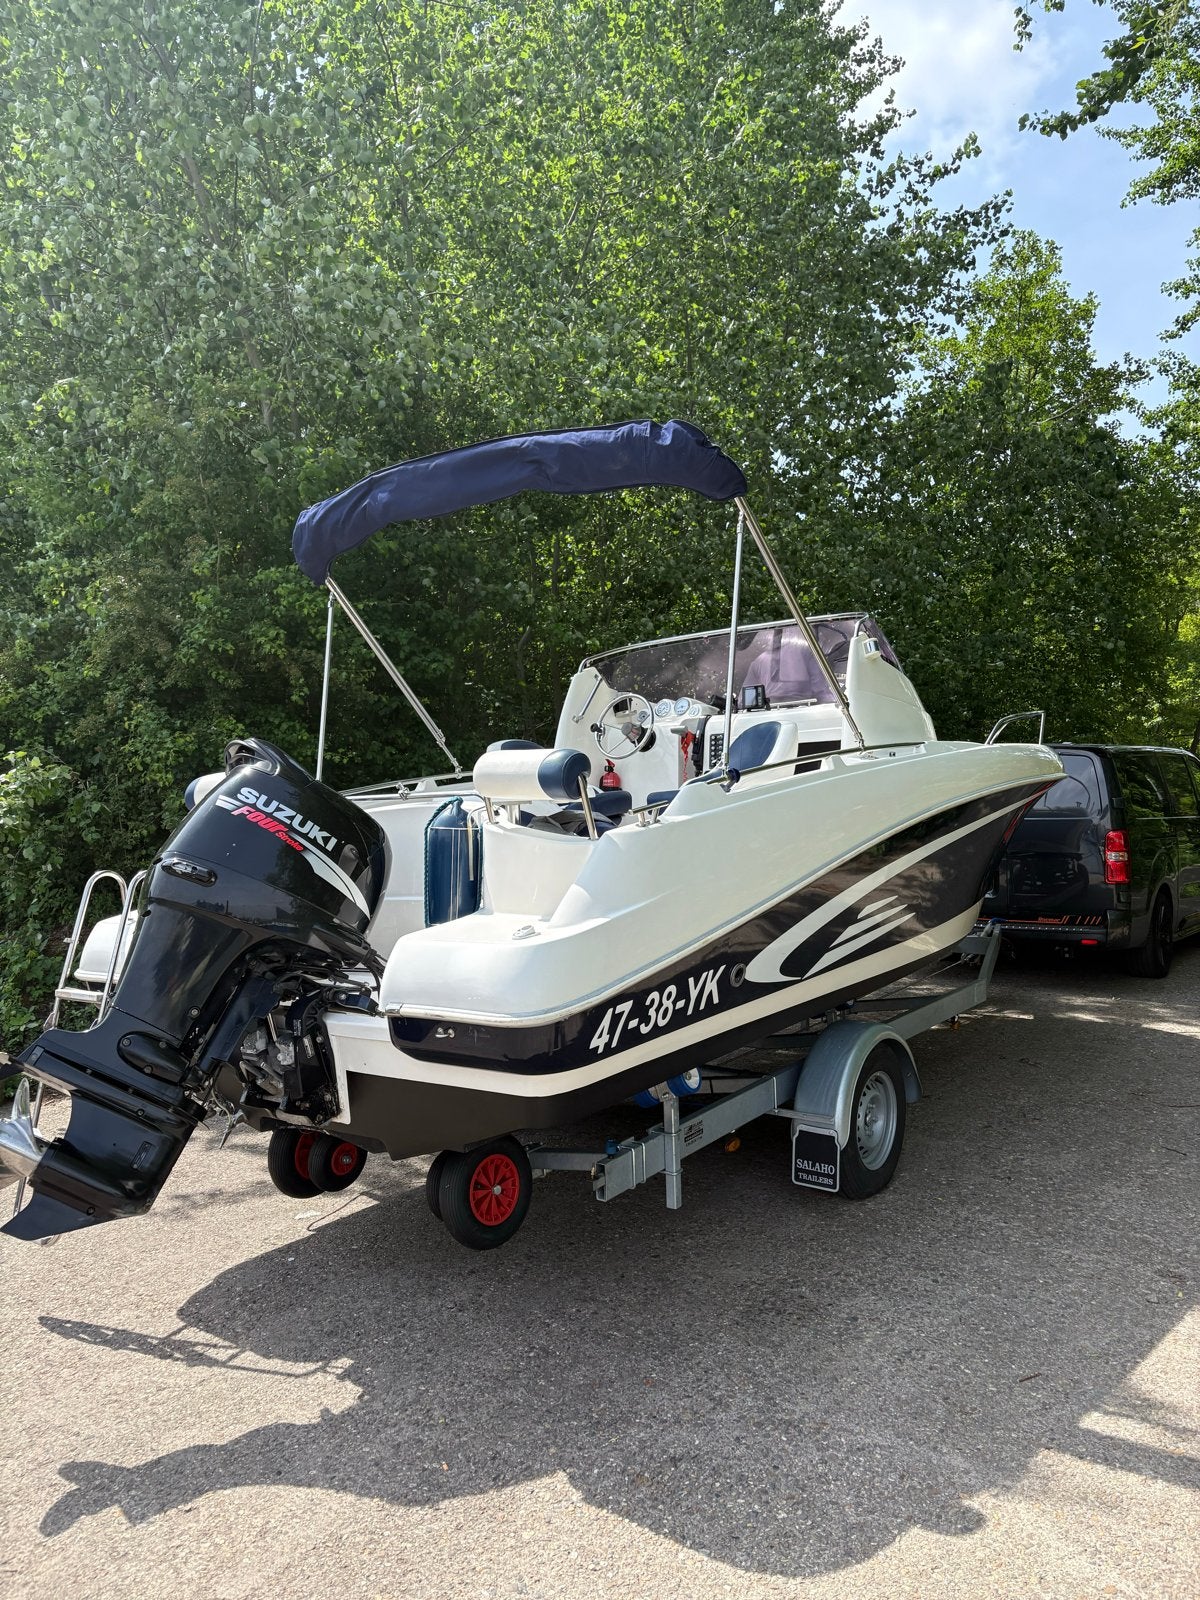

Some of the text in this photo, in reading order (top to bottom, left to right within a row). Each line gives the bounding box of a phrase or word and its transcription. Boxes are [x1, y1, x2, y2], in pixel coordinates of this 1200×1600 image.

[236, 786, 338, 852] SUZUKI
[589, 964, 727, 1054] 47-38-YK
[796, 1158, 835, 1175] SALAHO
[797, 1171, 834, 1186] TRAILERS
